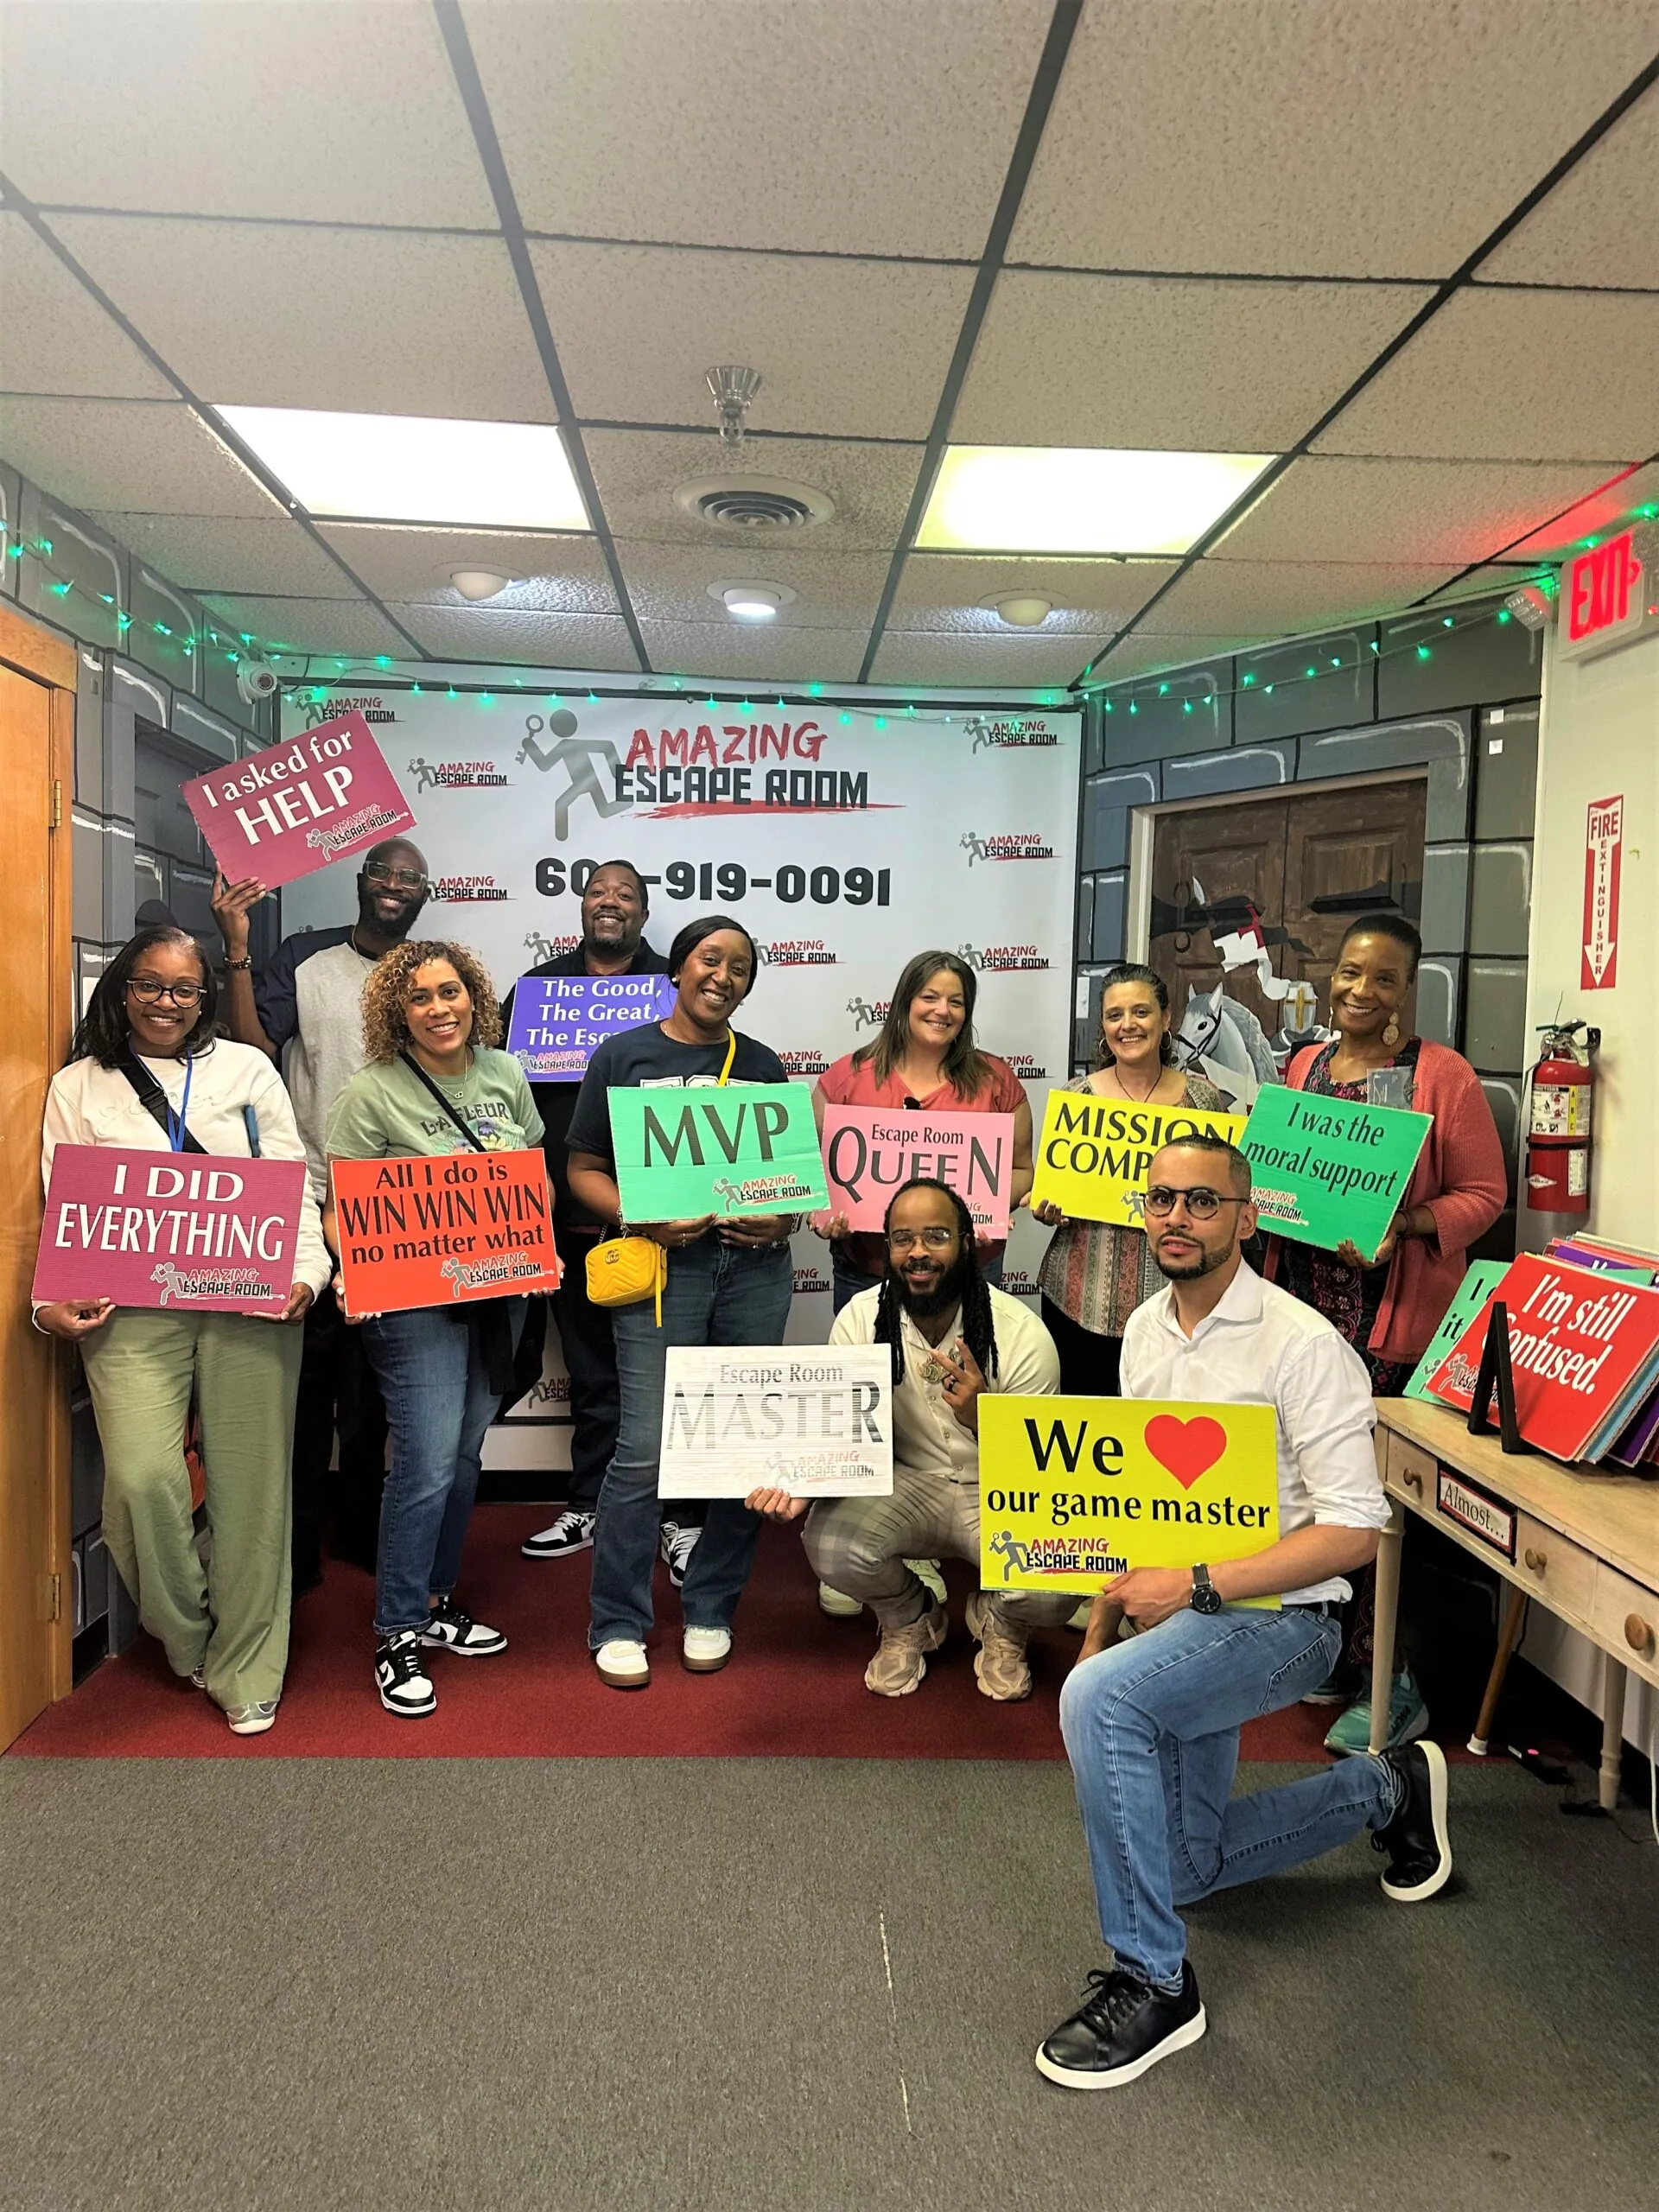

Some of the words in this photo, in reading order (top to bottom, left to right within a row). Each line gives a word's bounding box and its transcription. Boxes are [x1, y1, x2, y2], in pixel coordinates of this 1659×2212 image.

[1568, 533, 1632, 642] EXIT
[326, 696, 383, 710] AMAZING
[365, 710, 395, 722] ROOM
[992, 720, 1046, 734] AMAZING
[625, 721, 829, 772] AMAZING
[989, 733, 1026, 744] ESCAPE
[1029, 734, 1057, 746] ROOM
[201, 784, 219, 808] I
[221, 744, 308, 802] asked
[309, 730, 353, 764] for
[438, 760, 495, 774] AMAZING
[435, 772, 474, 785] ESCAPE
[477, 774, 508, 786] ROOM
[614, 763, 752, 804] ESCAPE
[766, 770, 868, 809] ROOM
[233, 765, 353, 845] HELP
[333, 804, 381, 836] AMAZING
[333, 823, 370, 845] ESCAPE
[370, 810, 397, 830] ROOM
[1591, 810, 1619, 841] FIRE
[988, 833, 1041, 847] AMAZING
[984, 845, 1022, 857] ESCAPE
[1025, 846, 1053, 858] ROOM
[438, 875, 496, 888] AMAZING
[535, 857, 892, 906] 60-919-0091
[435, 887, 474, 899] ESCAPE
[477, 888, 508, 900] ROOM
[1594, 839, 1607, 976] EXTINGUISHER
[771, 939, 825, 952] AMAZING
[984, 944, 1038, 958] AMAZING
[767, 951, 804, 963] ESCAPE
[808, 952, 836, 963] ROOM
[981, 957, 1018, 969] ESCAPE
[1020, 957, 1049, 969] ROOM
[543, 979, 585, 997] The
[591, 976, 663, 998] Good,
[538, 1002, 582, 1021] The
[588, 1002, 660, 1023] Great,
[526, 1027, 569, 1046] The
[575, 1027, 619, 1046] Esc
[533, 1060, 567, 1070] ESCAPE
[570, 1059, 588, 1070] ROO
[537, 1049, 587, 1062] AMAZING
[778, 1050, 823, 1063] MAZING
[1006, 1055, 1034, 1067] ZING
[784, 1062, 803, 1074] APE
[1017, 1067, 1046, 1079] ROOM
[420, 1115, 452, 1137] LA
[1287, 1103, 1301, 1128] I
[1301, 1111, 1345, 1139] was
[1346, 1114, 1385, 1147] the
[644, 1102, 790, 1168] MVP
[872, 1123, 918, 1147] Escape
[923, 1127, 964, 1145] Room
[828, 1125, 1002, 1205] QUEEN
[1046, 1137, 1154, 1182] COMP
[376, 1163, 416, 1191] All
[424, 1163, 435, 1186] I
[445, 1160, 480, 1185] do
[487, 1158, 508, 1182] is
[1244, 1141, 1313, 1175] moral
[1308, 1159, 1399, 1198] support
[112, 1163, 129, 1196] I
[145, 1166, 245, 1204] DID
[741, 1174, 797, 1192] AMAZING
[740, 1185, 779, 1201] ESCAPE
[782, 1185, 812, 1198] ROOM
[340, 1193, 407, 1239] WIN
[412, 1187, 479, 1232] WIN
[481, 1183, 547, 1225] WIN
[972, 1214, 993, 1224] OOM
[1275, 1205, 1302, 1221] ROOM
[54, 1201, 285, 1262] EVERYTHING
[351, 1243, 385, 1265] no
[392, 1233, 477, 1261] matter
[486, 1224, 545, 1251] what
[472, 1250, 529, 1270] AMAZING
[187, 1268, 260, 1284] AMAZING
[467, 1266, 509, 1284] ESCAPE
[511, 1262, 543, 1278] ROOM
[792, 1268, 819, 1281] ZING
[1001, 1271, 1029, 1283] ZING
[182, 1281, 231, 1296] ESCAPE
[234, 1284, 271, 1298] ROOM
[802, 1281, 830, 1291] ROOM
[1011, 1283, 1040, 1295] ROOM
[1522, 1274, 1573, 1324] I'm
[1567, 1292, 1637, 1342] still
[720, 1364, 783, 1388] Escape
[790, 1363, 843, 1383] Room
[665, 1381, 884, 1450] MASTER
[1024, 1417, 1124, 1477] We
[796, 1450, 861, 1467] AMAZING
[792, 1465, 837, 1478] ESCAPE
[840, 1464, 874, 1477] ROOM
[987, 1488, 1040, 1514] our
[1051, 1491, 1141, 1527] game
[1152, 1496, 1270, 1529] master
[1444, 1482, 1505, 1540] Almost...
[1030, 1537, 1110, 1554] AMAZING
[1025, 1552, 1081, 1570] ESCAPE
[1085, 1555, 1128, 1573] ROOM
